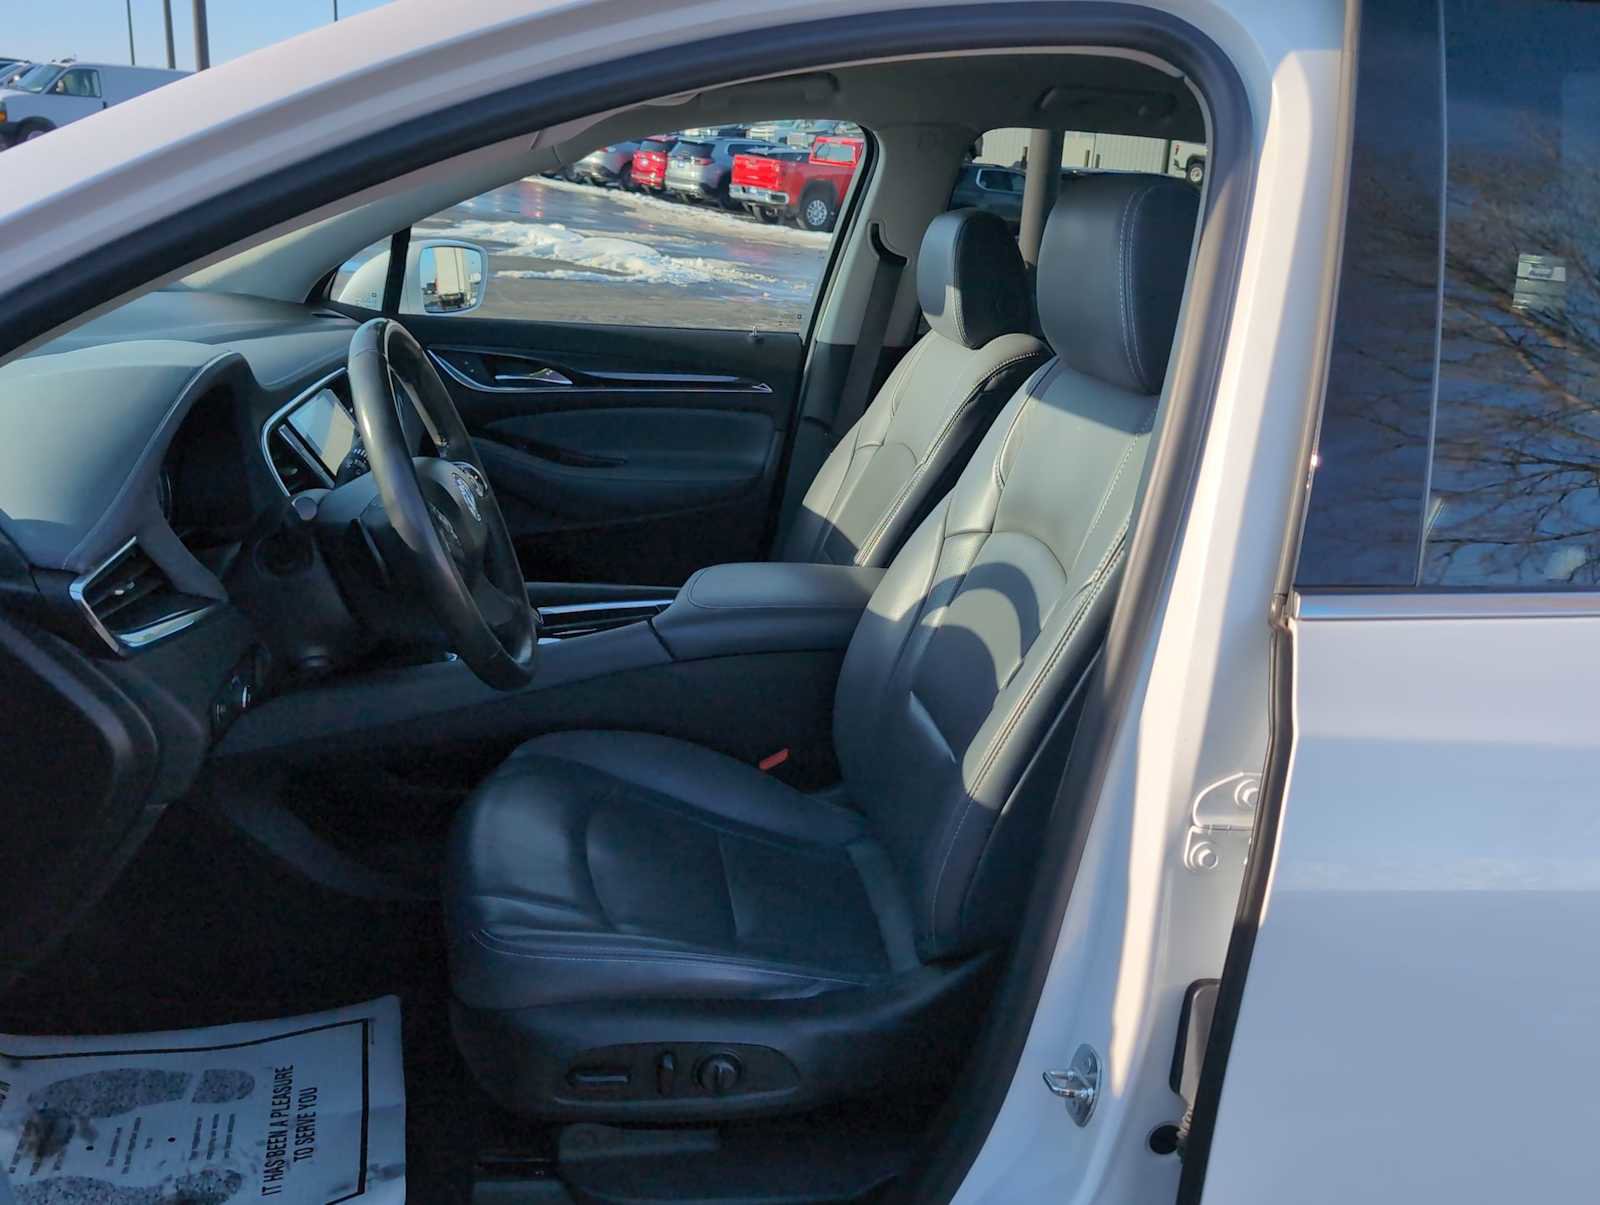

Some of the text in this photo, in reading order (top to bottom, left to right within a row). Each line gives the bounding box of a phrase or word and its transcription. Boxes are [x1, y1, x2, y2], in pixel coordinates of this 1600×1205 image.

[262, 1064, 294, 1197] IT HAS BEEN A PLEASURE
[293, 1086, 318, 1162] TO SERVE YOU
